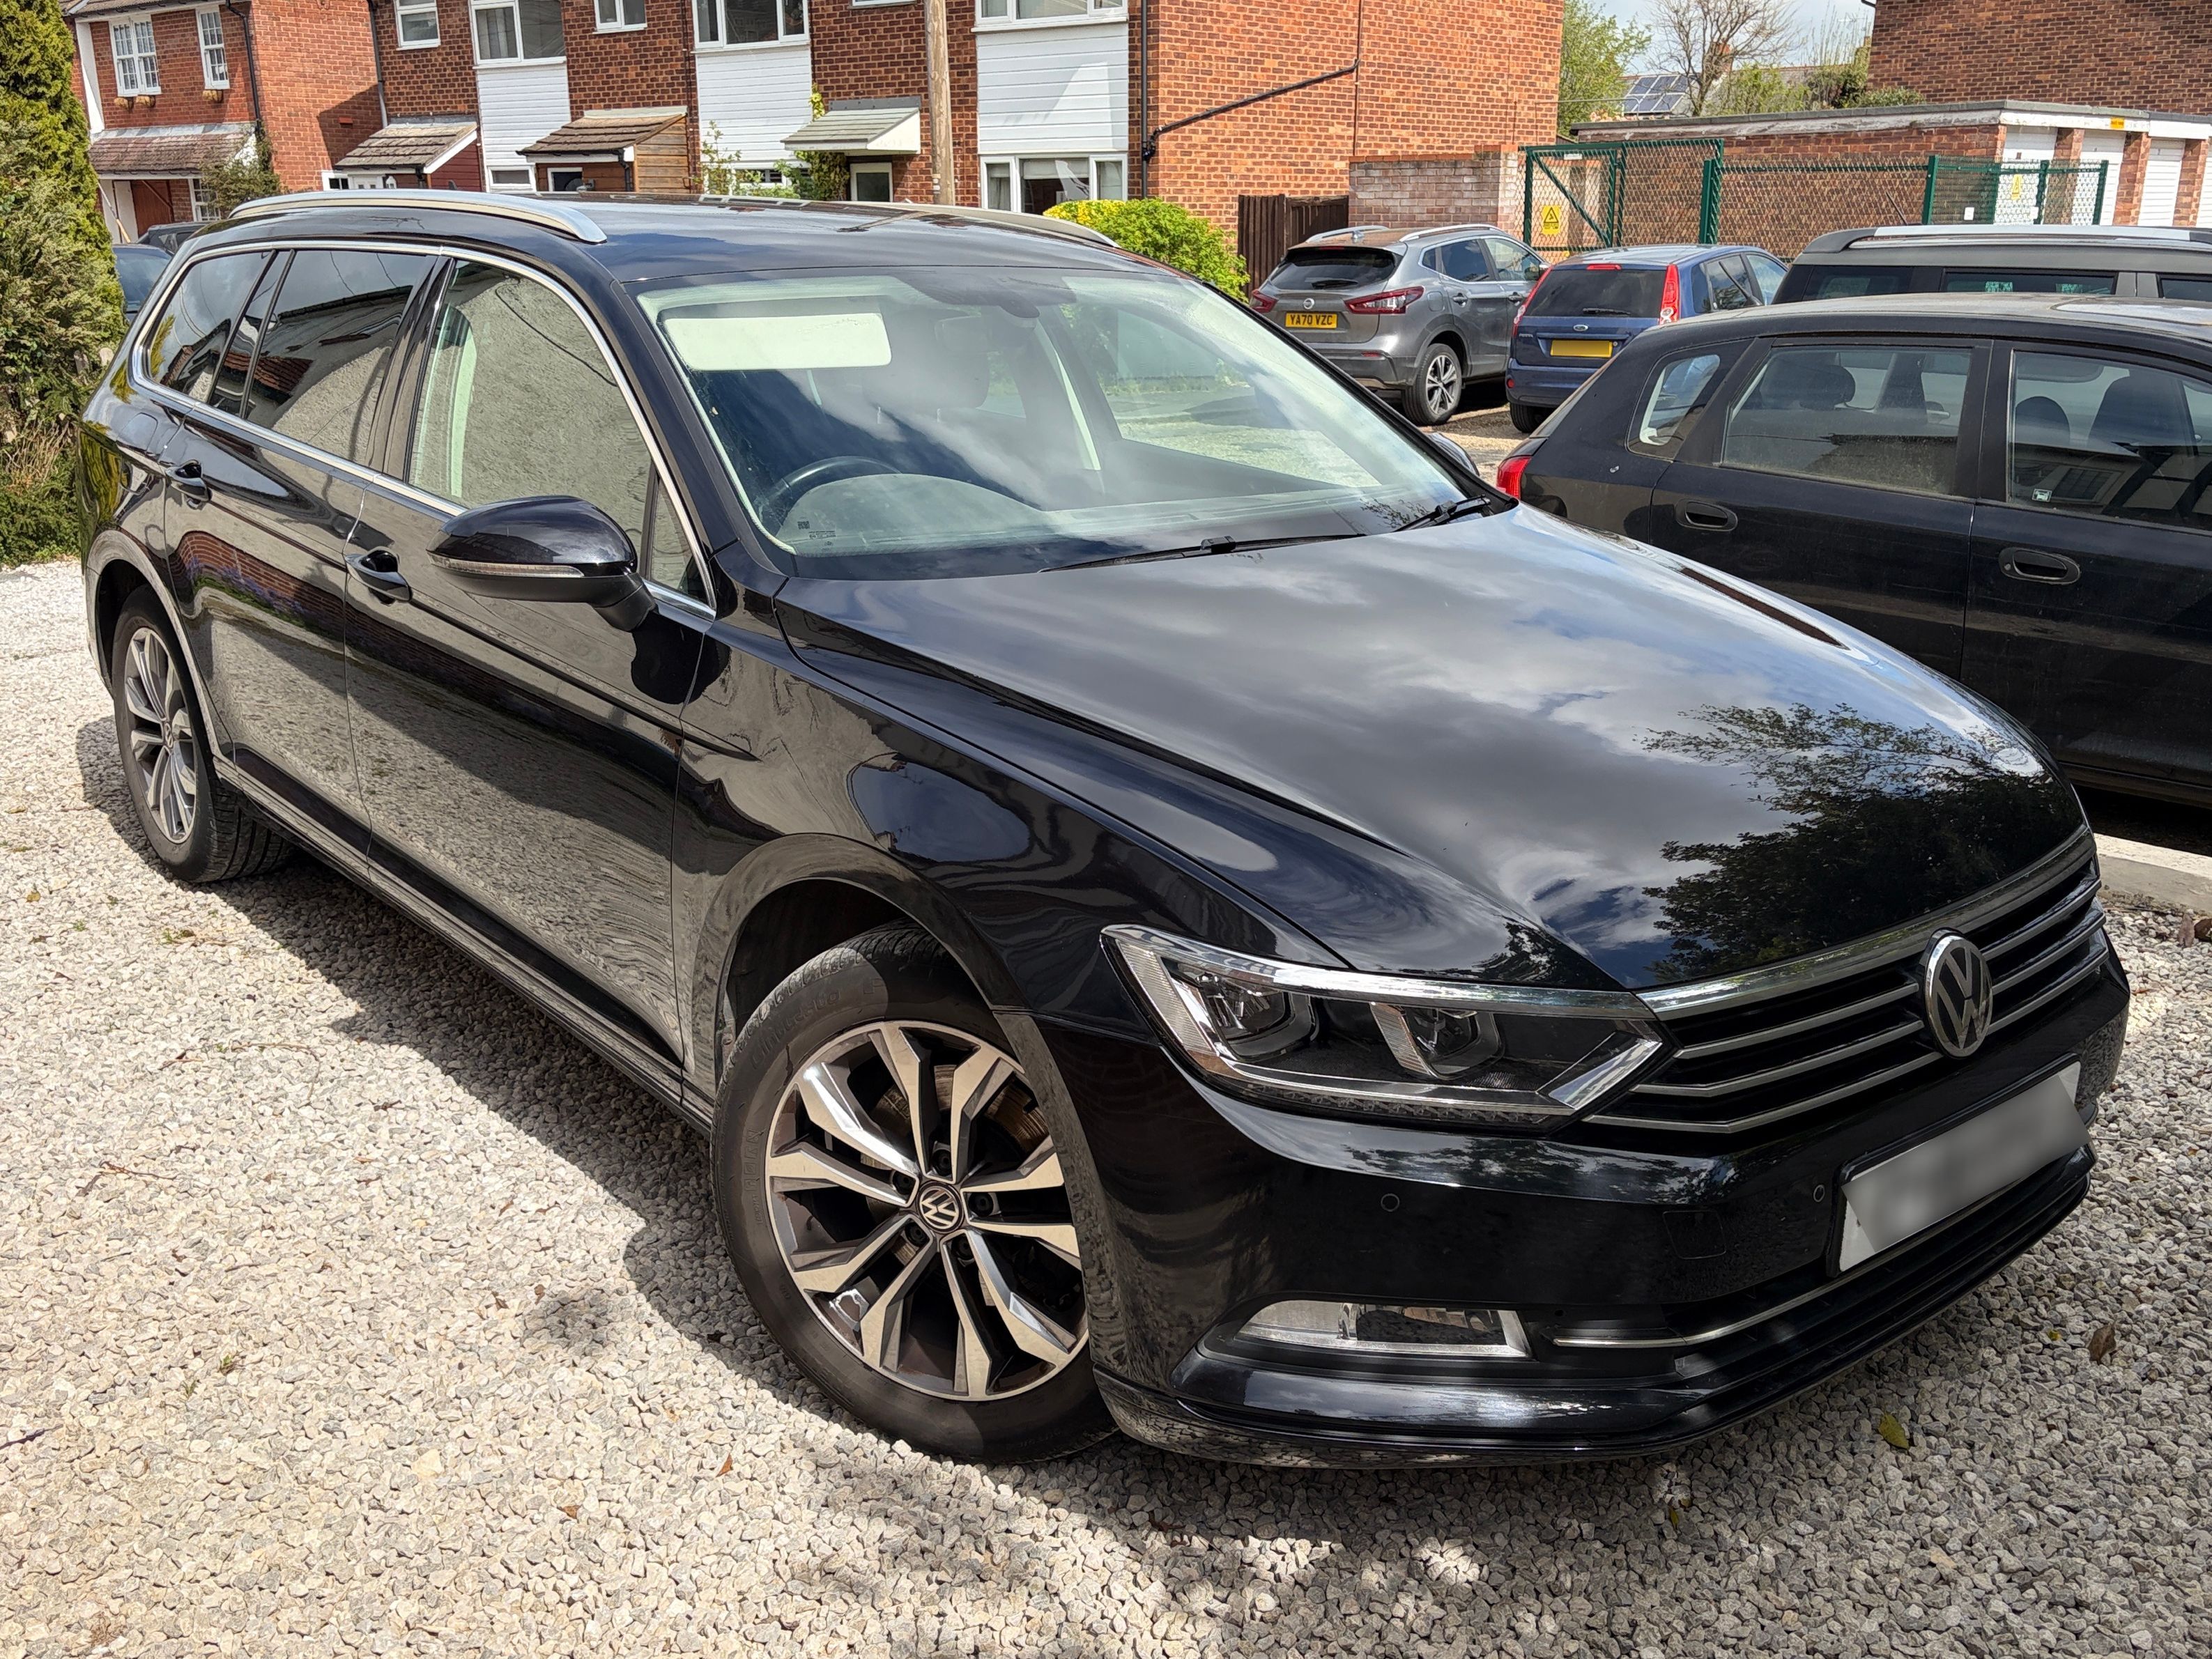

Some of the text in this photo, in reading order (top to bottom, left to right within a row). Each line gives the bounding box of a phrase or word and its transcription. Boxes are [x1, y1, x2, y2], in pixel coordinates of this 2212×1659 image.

[1290, 314, 1333, 326] YA70 VZC
[1930, 941, 1988, 1053] VW
[919, 1185, 959, 1229] VW
